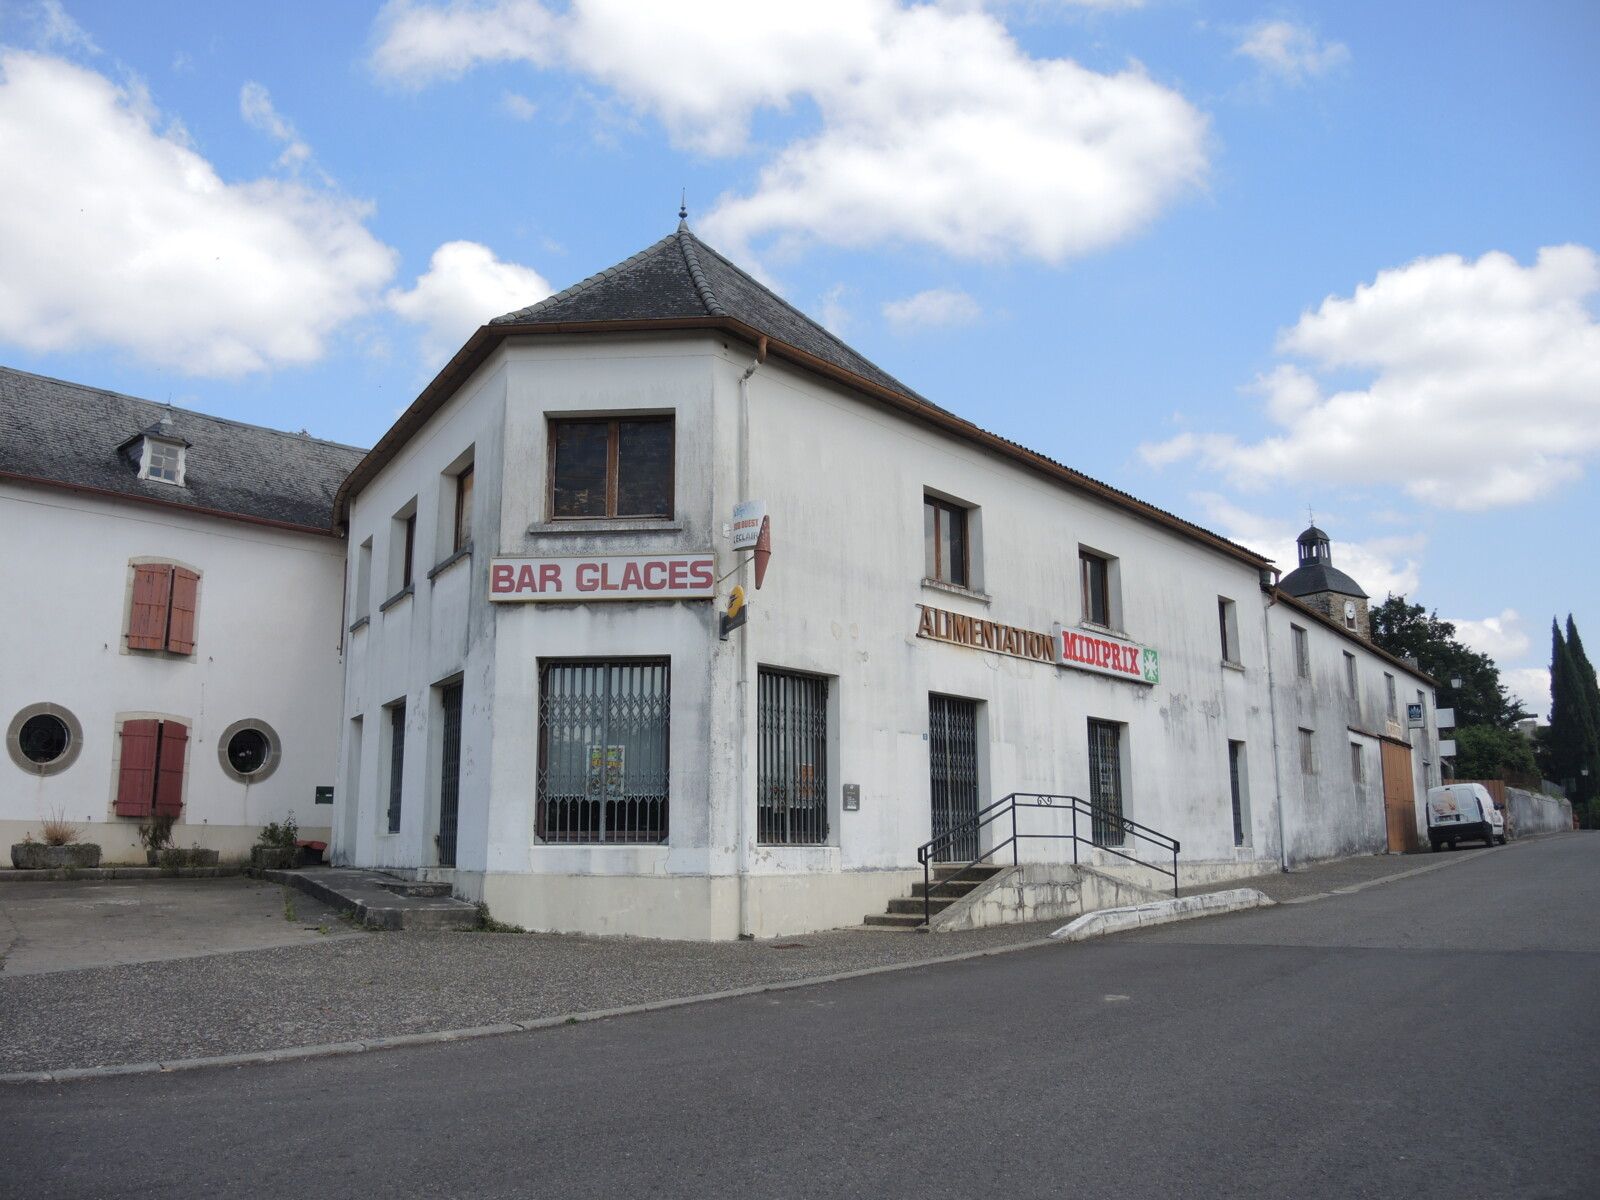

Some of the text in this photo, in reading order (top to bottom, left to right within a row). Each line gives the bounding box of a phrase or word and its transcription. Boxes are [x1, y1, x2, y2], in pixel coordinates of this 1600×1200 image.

[492, 560, 714, 593] BAR GLACES
[917, 605, 1056, 662] ALIMENTATION
[1062, 630, 1141, 676] MIDIPRIX
